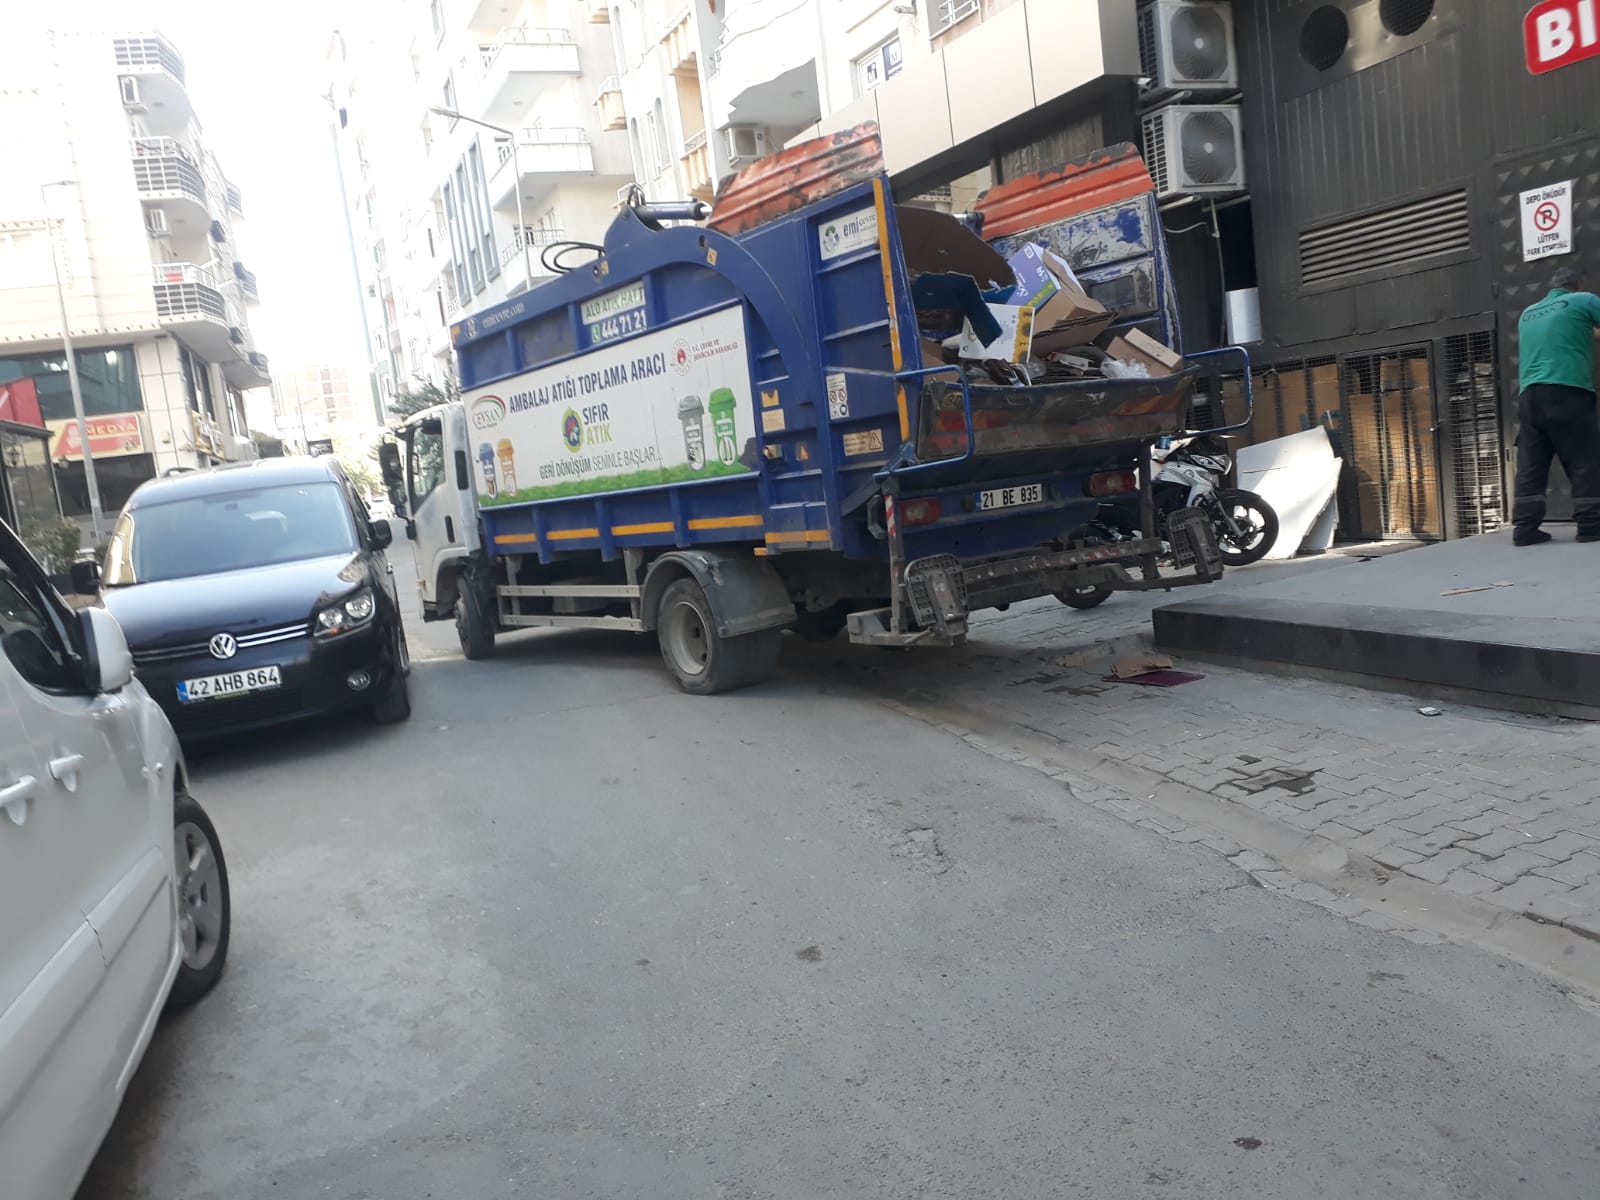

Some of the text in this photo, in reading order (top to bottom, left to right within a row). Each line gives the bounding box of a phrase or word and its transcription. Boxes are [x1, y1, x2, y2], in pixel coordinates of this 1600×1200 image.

[1536, 0, 1597, 62] BI
[1537, 232, 1560, 244] LÜTFEN
[602, 309, 648, 339] 444 71 21
[509, 352, 666, 414] AMBALAJ ATIĞI TOPLAMA ARACI
[582, 403, 610, 425] SIFIR
[586, 423, 612, 446] ATIK
[982, 486, 1038, 508] 21 BE 835
[189, 680, 209, 697] 42
[214, 674, 244, 693] AHB
[246, 668, 278, 687] 864
